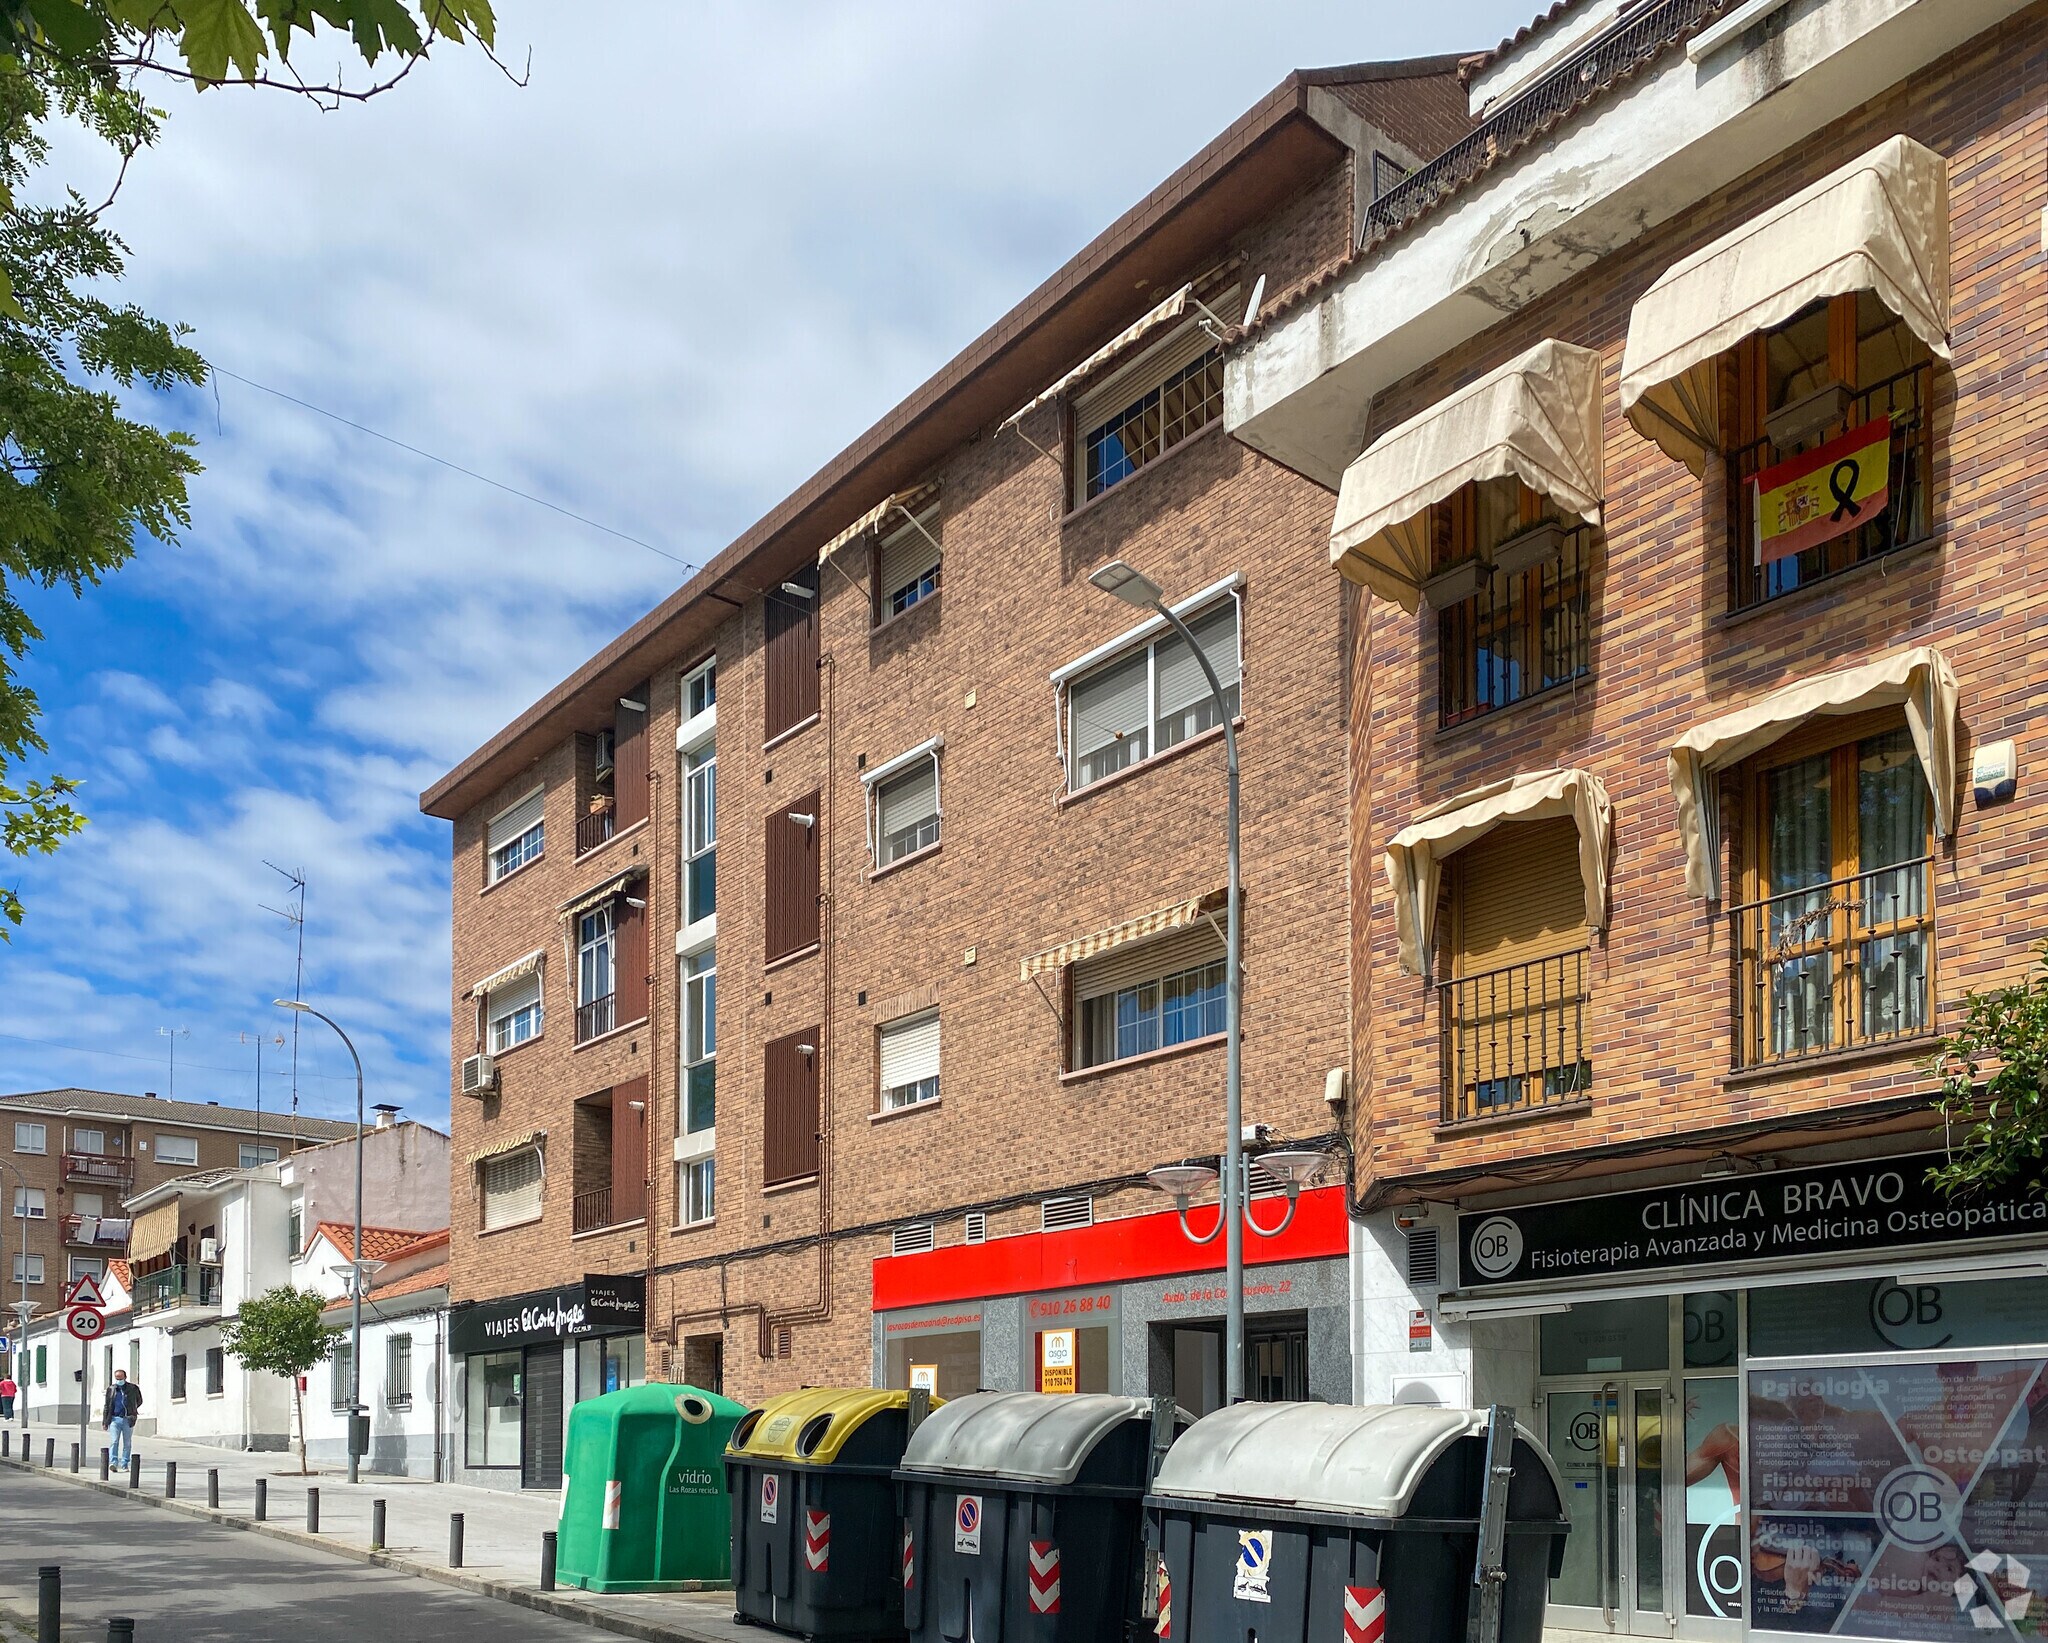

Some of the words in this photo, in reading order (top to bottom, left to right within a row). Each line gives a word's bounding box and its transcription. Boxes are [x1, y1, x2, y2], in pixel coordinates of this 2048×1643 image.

[1642, 1189, 1765, 1230] CLÍNICA
[1783, 1172, 1904, 1215] BRAVO
[1531, 1241, 1639, 1269] Fisioterapia
[1645, 1229, 1748, 1258] Avanzada
[1753, 1230, 1766, 1251] y
[1772, 1217, 1879, 1244] Medicina
[1887, 1200, 2047, 1232] Osteopática
[590, 1289, 615, 1297] VIAJES
[1279, 1280, 1292, 1293] 22
[590, 1297, 598, 1307] El
[598, 1297, 615, 1308] Corte
[615, 1297, 640, 1311] Inglés
[1040, 1301, 1060, 1317] 910
[1063, 1299, 1076, 1314] 26
[1079, 1297, 1093, 1312] 88
[1096, 1295, 1111, 1310] 40
[76, 1317, 98, 1329] 20
[485, 1317, 519, 1338] VIAJES
[521, 1307, 532, 1332] El
[532, 1306, 555, 1331] Corte
[555, 1296, 585, 1336] Inglé
[1048, 1349, 1068, 1360] asga
[1044, 1368, 1072, 1377] DISPONIBLE
[1761, 1376, 1890, 1400] Psicología
[678, 1469, 712, 1485] vidrio
[1762, 1472, 1872, 1491] Fisioterapia
[680, 1486, 698, 1494] Rozas
[698, 1487, 719, 1495] recicla
[1762, 1488, 1849, 1503] avanzada
[1758, 1520, 1825, 1537] Terapia
